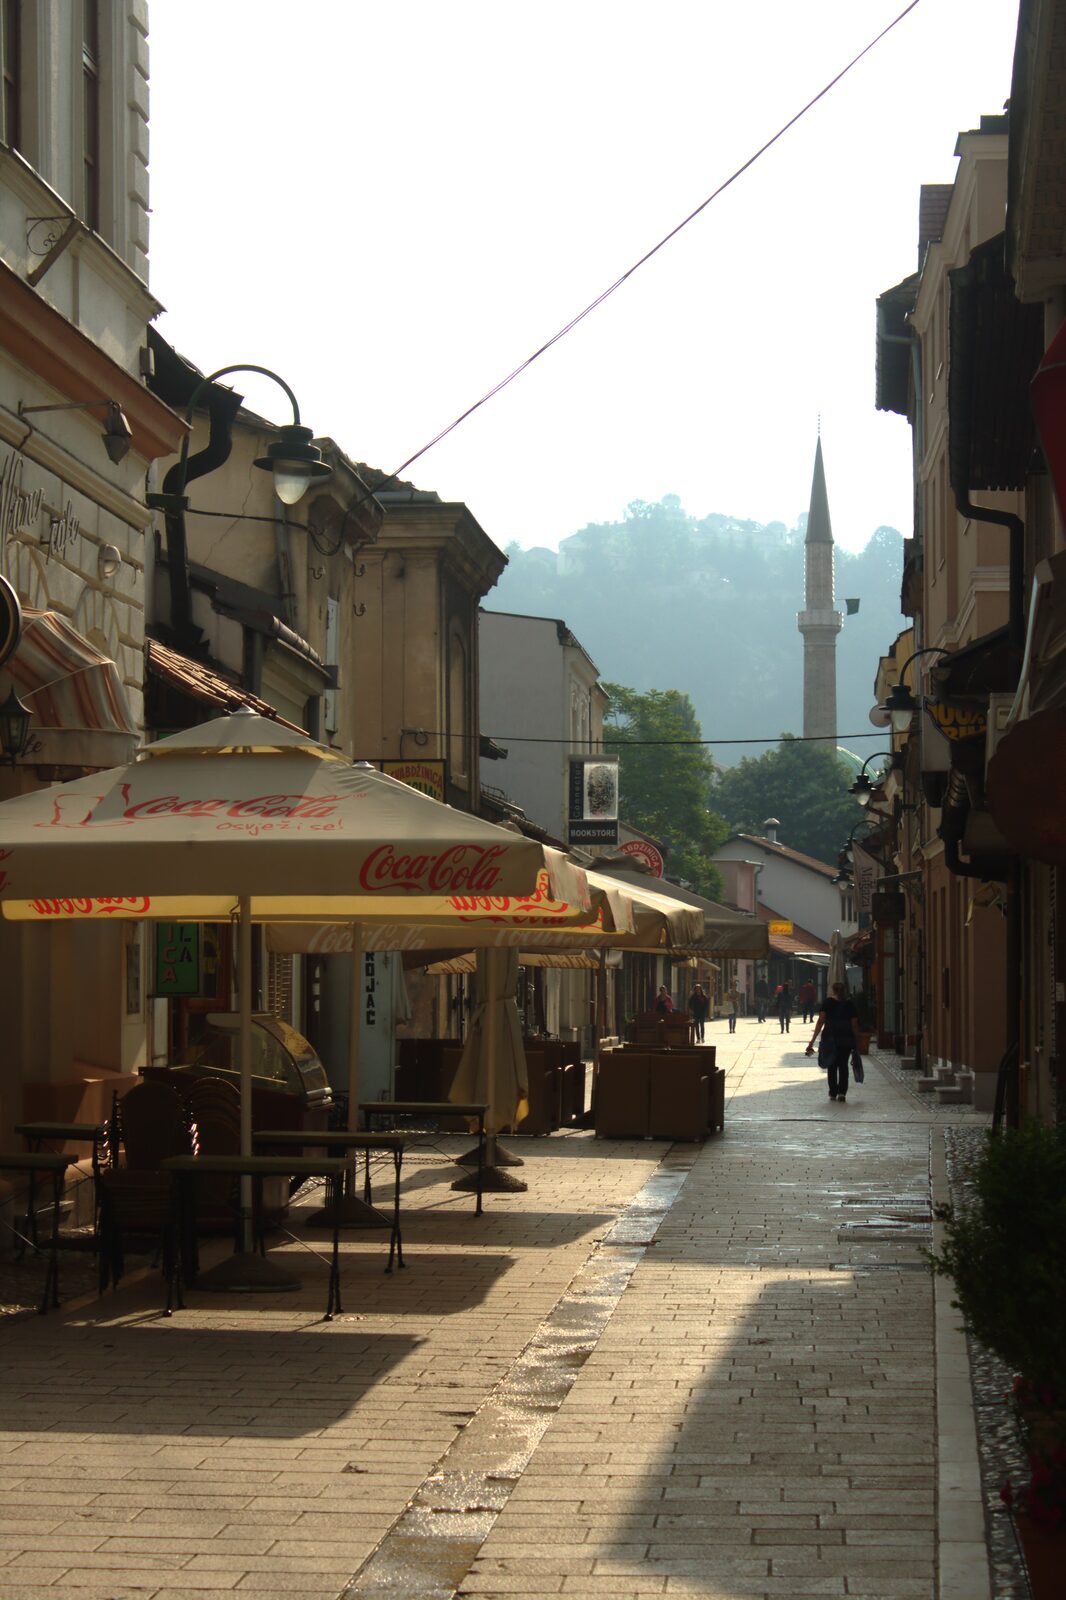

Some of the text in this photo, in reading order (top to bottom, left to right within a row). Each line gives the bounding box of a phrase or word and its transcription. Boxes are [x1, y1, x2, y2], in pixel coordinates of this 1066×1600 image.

[124, 794, 351, 819] Coca-Cola
[570, 829, 616, 838] BOOKSTORE
[360, 844, 509, 892] Coca-Cola
